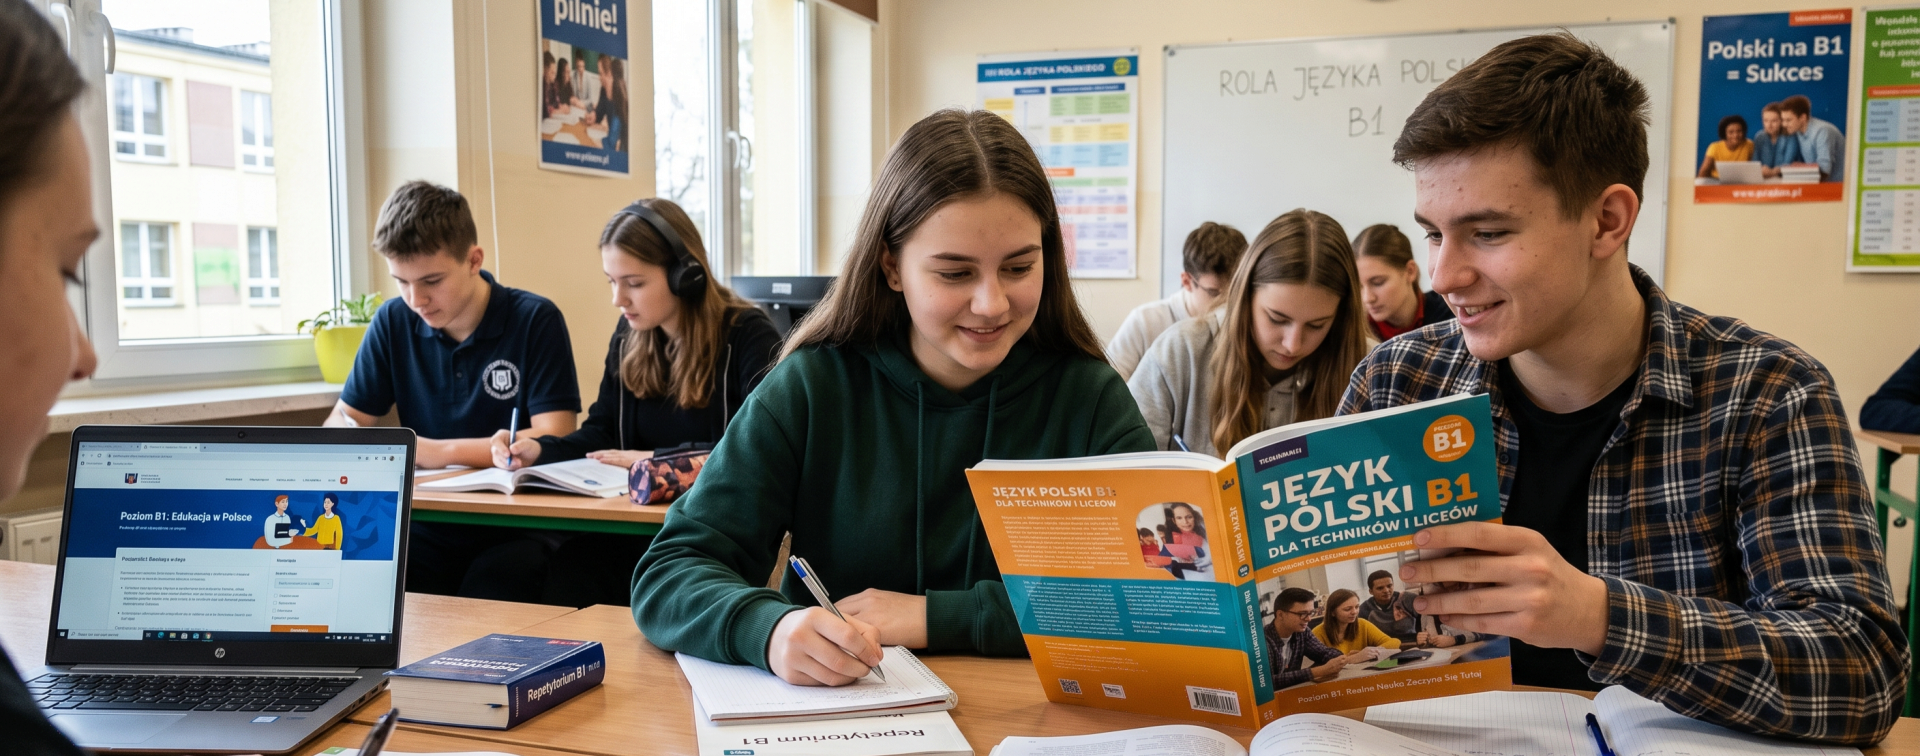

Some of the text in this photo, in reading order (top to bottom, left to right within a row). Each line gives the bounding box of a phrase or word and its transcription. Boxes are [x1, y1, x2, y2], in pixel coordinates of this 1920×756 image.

[554, 0, 618, 35] pilnie!
[1708, 35, 1844, 60] Polski na B1
[1219, 69, 1278, 97] ROLA
[1293, 63, 1382, 101] JĘZYKA
[1745, 62, 1824, 83] Sukces
[1349, 105, 1386, 138] B1
[1433, 428, 1467, 453] B1
[992, 486, 1037, 499] JĘZYK
[1039, 486, 1092, 497] POLSKI
[1260, 455, 1394, 511] JĘZYK
[120, 511, 253, 523] Poziom B1: Edukacja w Polsce
[995, 500, 1014, 508] DLA
[1073, 500, 1078, 508] I
[1264, 472, 1479, 543] POLSKI B1
[1268, 541, 1299, 559] DLA
[1301, 517, 1400, 549] TECHNIKÓW
[1404, 517, 1410, 529] I
[1413, 504, 1479, 527] LICEÓW
[527, 672, 576, 703] Repetytorium
[1297, 693, 1329, 704] Poziom
[1346, 686, 1375, 695] Realne
[1444, 673, 1459, 682] Się
[1459, 669, 1482, 679] Tutaj
[743, 729, 925, 745] Repetytorium B1
